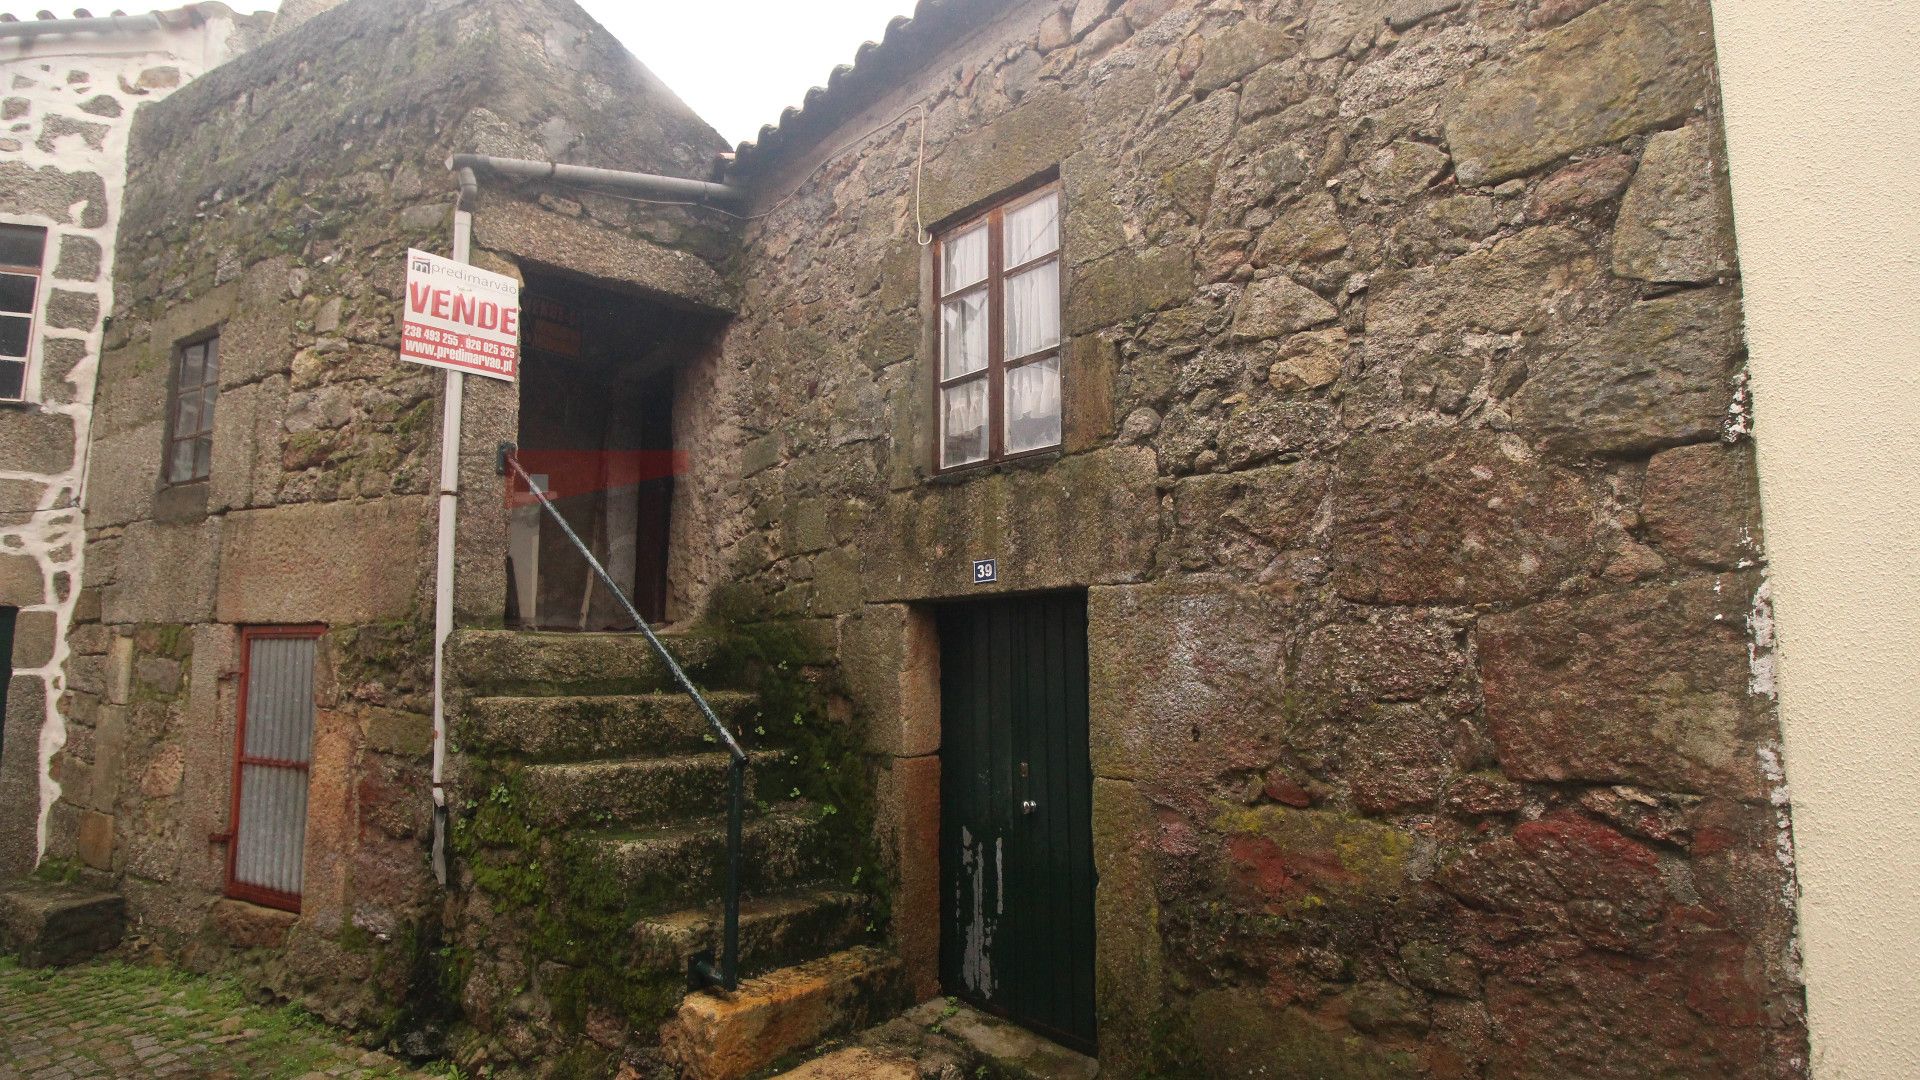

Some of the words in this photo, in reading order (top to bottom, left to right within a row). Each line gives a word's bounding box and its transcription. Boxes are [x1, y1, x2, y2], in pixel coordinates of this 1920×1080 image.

[431, 264, 517, 295] predimarvão
[409, 281, 517, 336] VENDE
[404, 325, 422, 338] 238
[424, 330, 440, 342] 493
[442, 333, 458, 346] 255
[500, 345, 514, 359] 325
[405, 339, 512, 372] www.predimarvao.pt
[977, 563, 993, 579] 39
